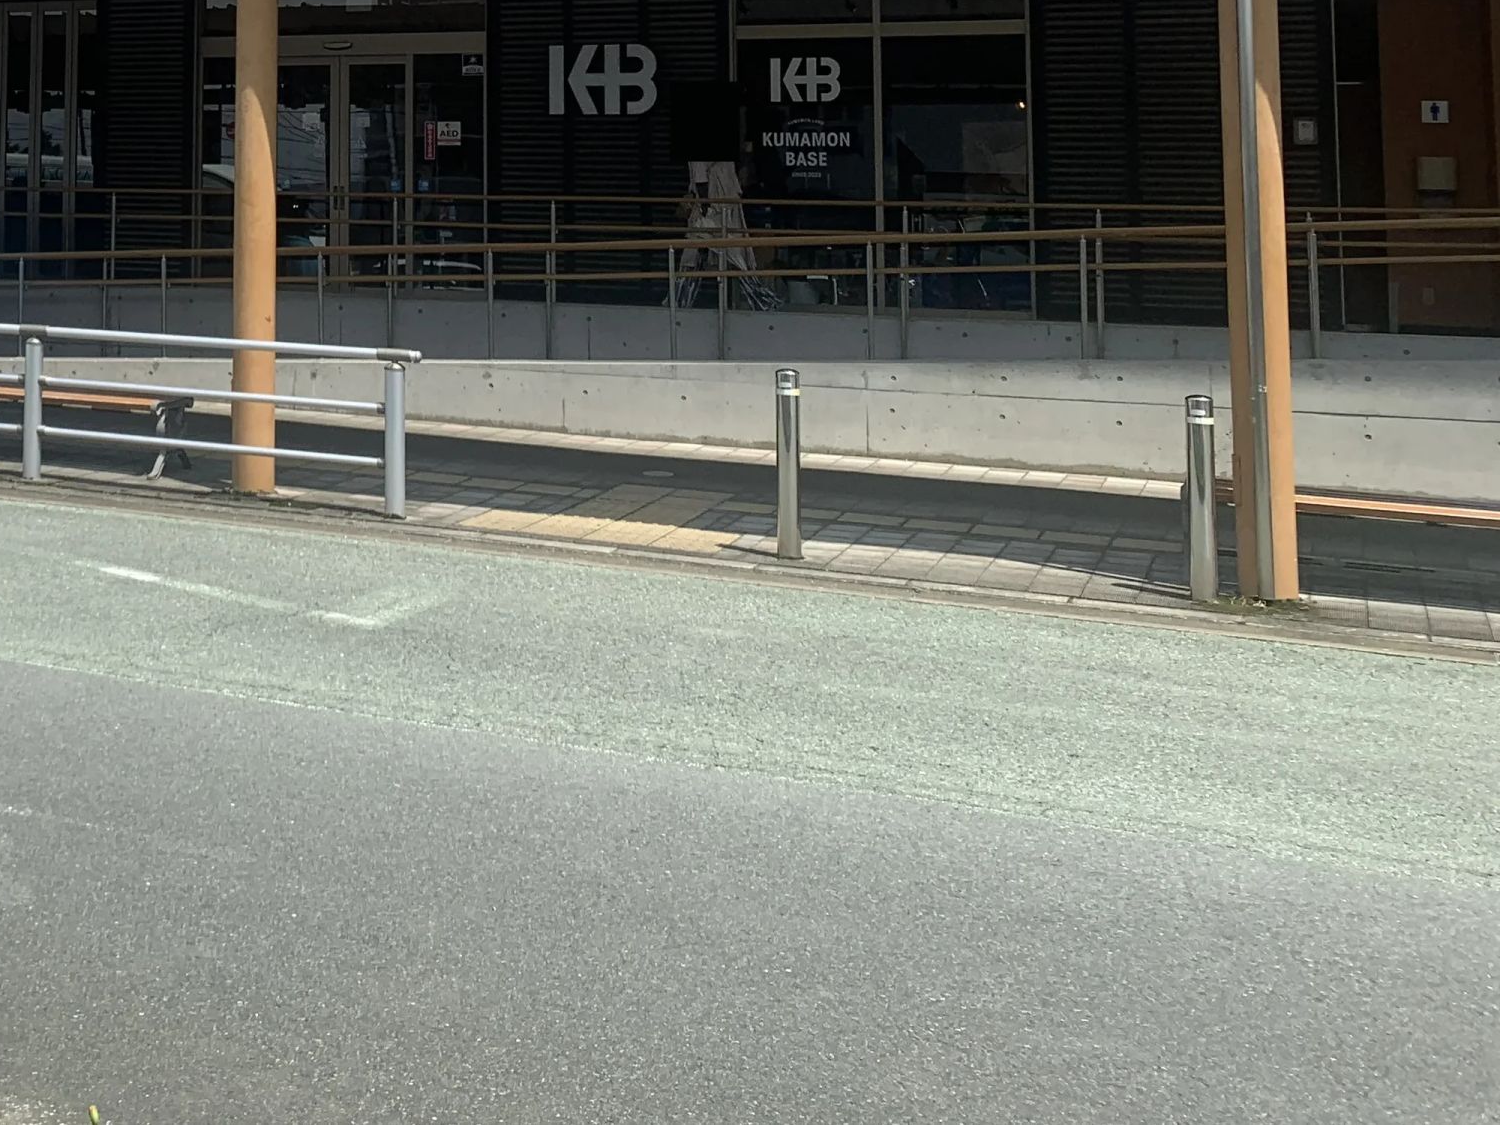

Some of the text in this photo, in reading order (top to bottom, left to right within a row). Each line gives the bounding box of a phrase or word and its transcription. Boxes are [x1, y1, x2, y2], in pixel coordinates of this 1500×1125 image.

[548, 43, 659, 116] KB
[769, 57, 841, 103] KB
[439, 130, 459, 138] AED
[762, 131, 851, 147] KUMAMON
[785, 151, 828, 167] BASE
